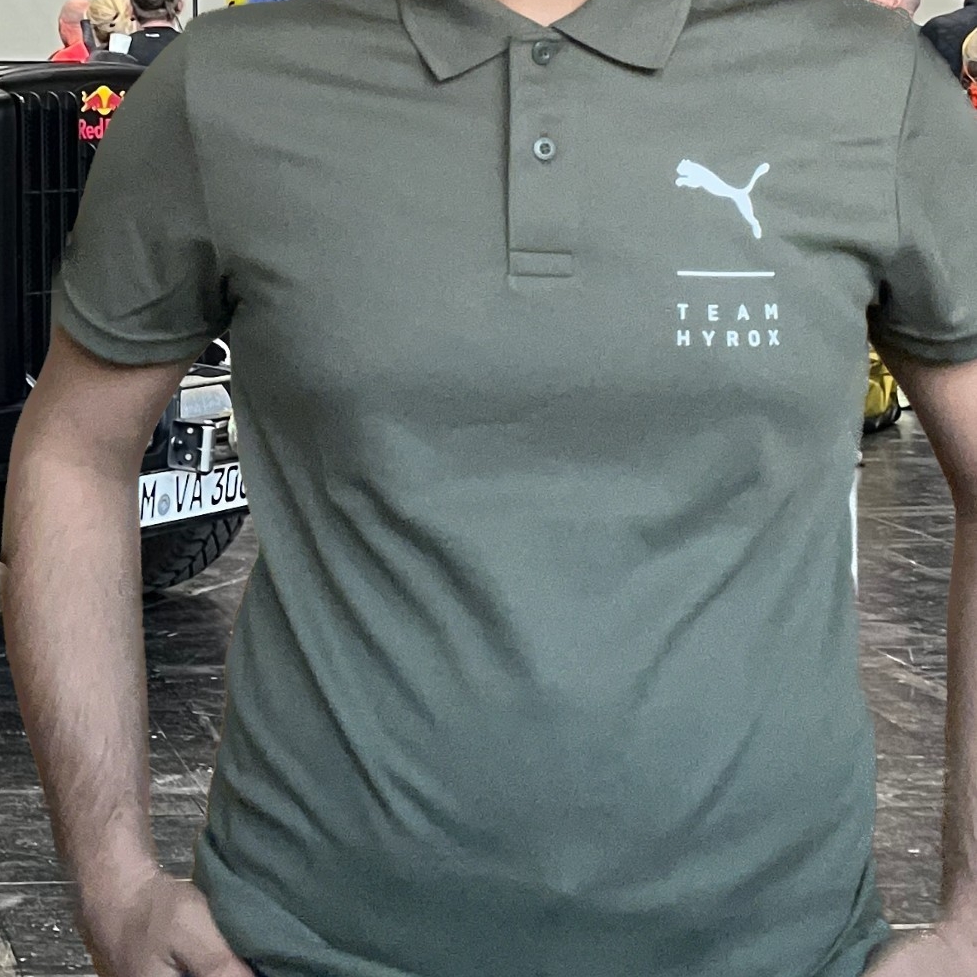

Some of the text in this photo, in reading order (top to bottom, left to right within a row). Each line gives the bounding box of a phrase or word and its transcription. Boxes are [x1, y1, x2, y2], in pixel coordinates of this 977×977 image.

[78, 118, 104, 140] Red
[677, 303, 779, 322] TEAM
[677, 329, 780, 347] HYROX
[140, 480, 157, 520] M
[176, 473, 203, 513] VA
